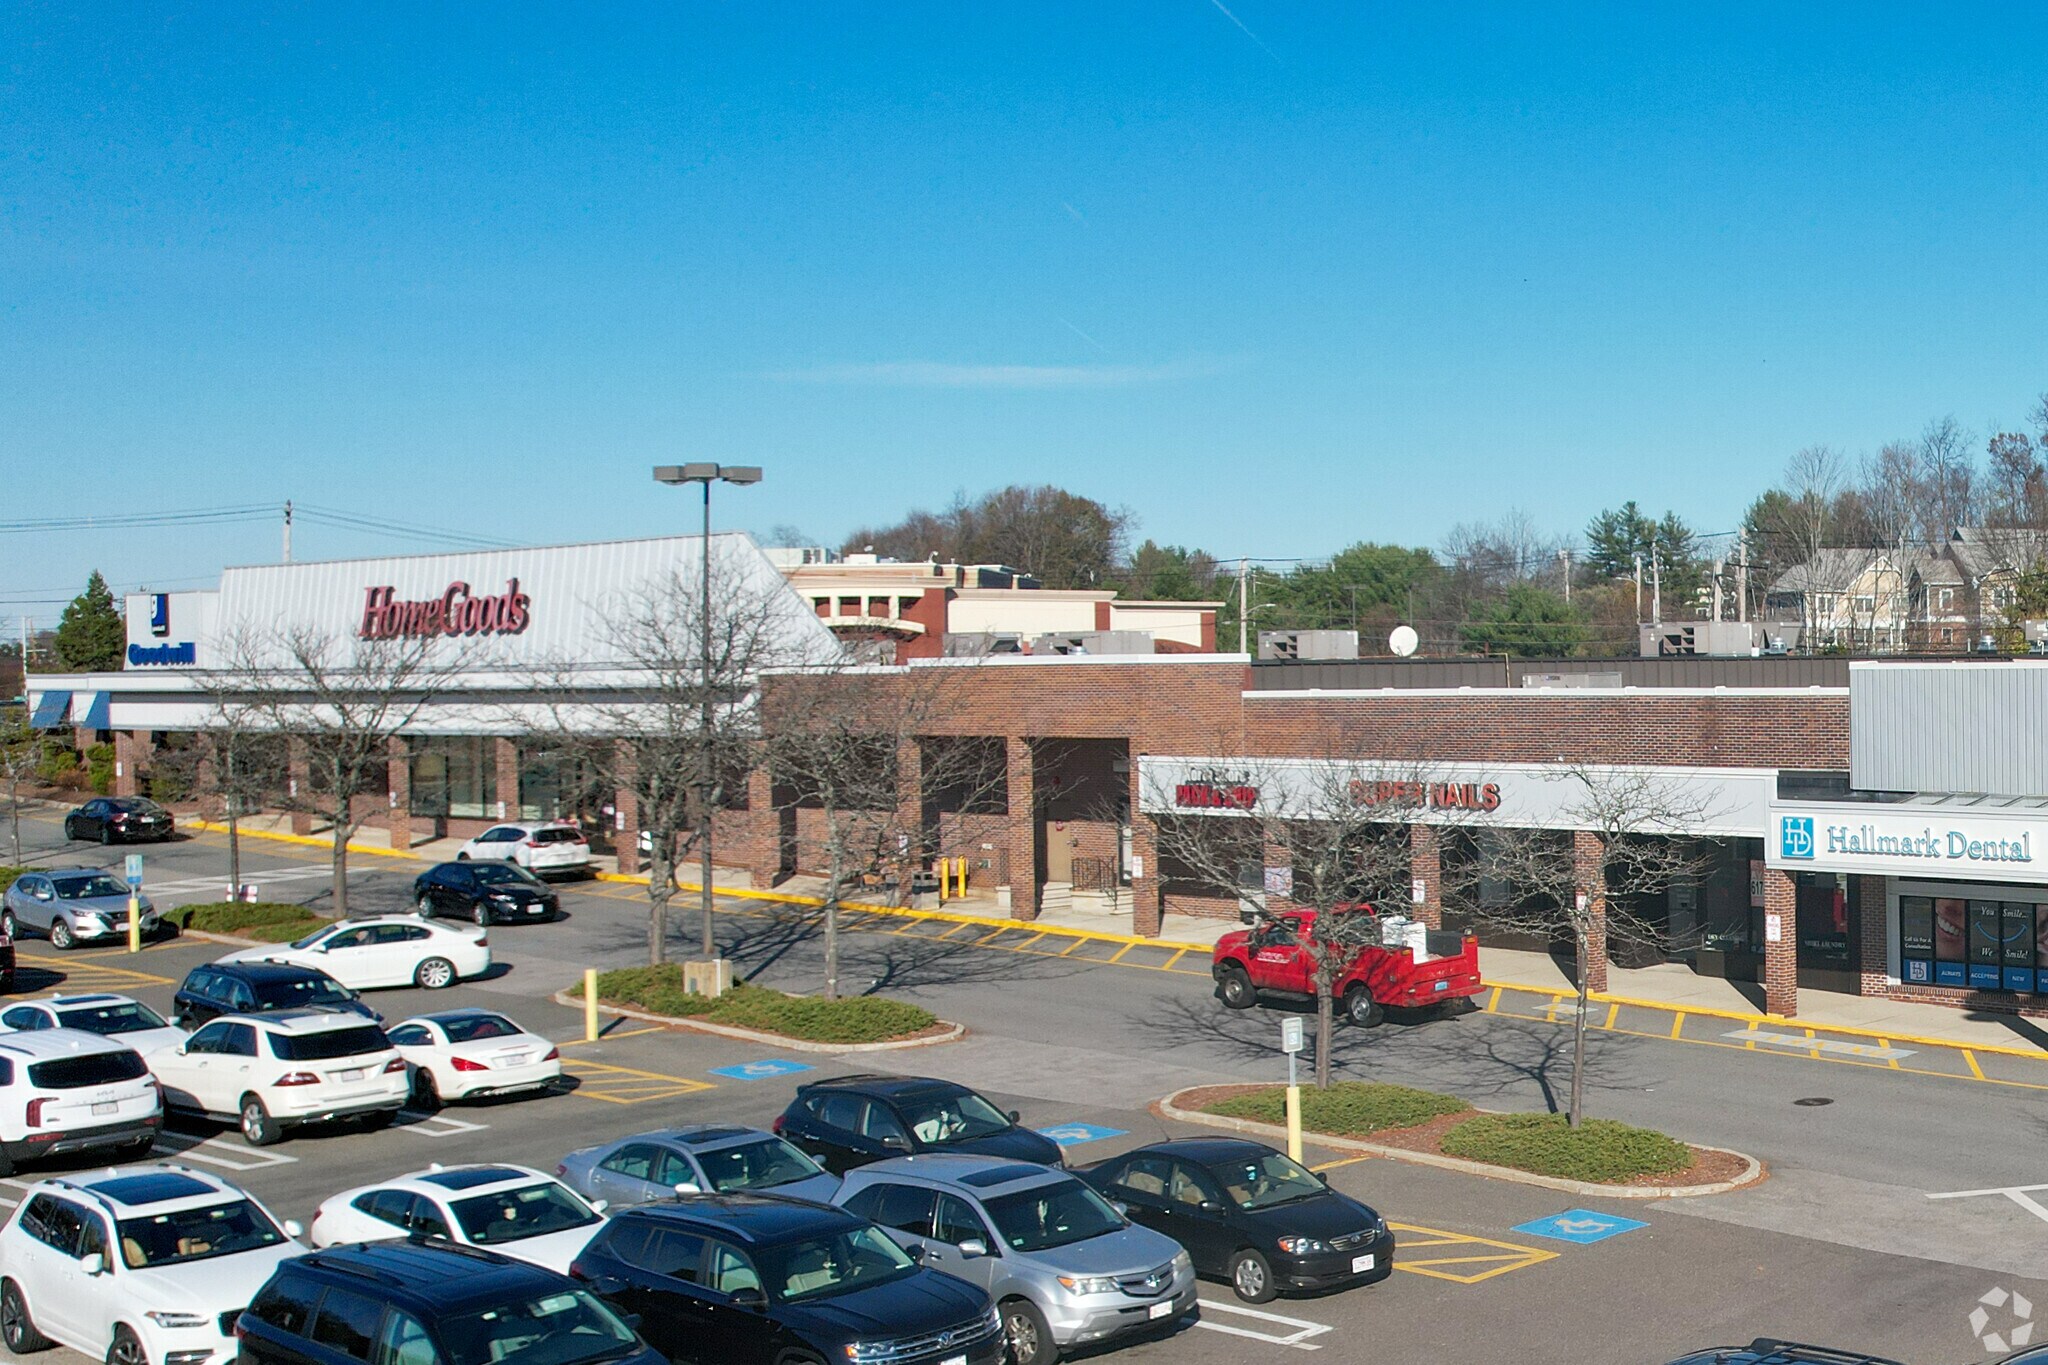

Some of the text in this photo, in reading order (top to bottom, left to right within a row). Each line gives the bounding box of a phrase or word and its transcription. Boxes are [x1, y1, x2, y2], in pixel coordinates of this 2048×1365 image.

[358, 577, 531, 641] HomeGoods
[128, 642, 196, 666] Goodwill
[1429, 783, 1501, 813] NAILS
[1827, 825, 1940, 856] Hallmark
[1946, 831, 2033, 862] Dental
[1981, 906, 1995, 916] You
